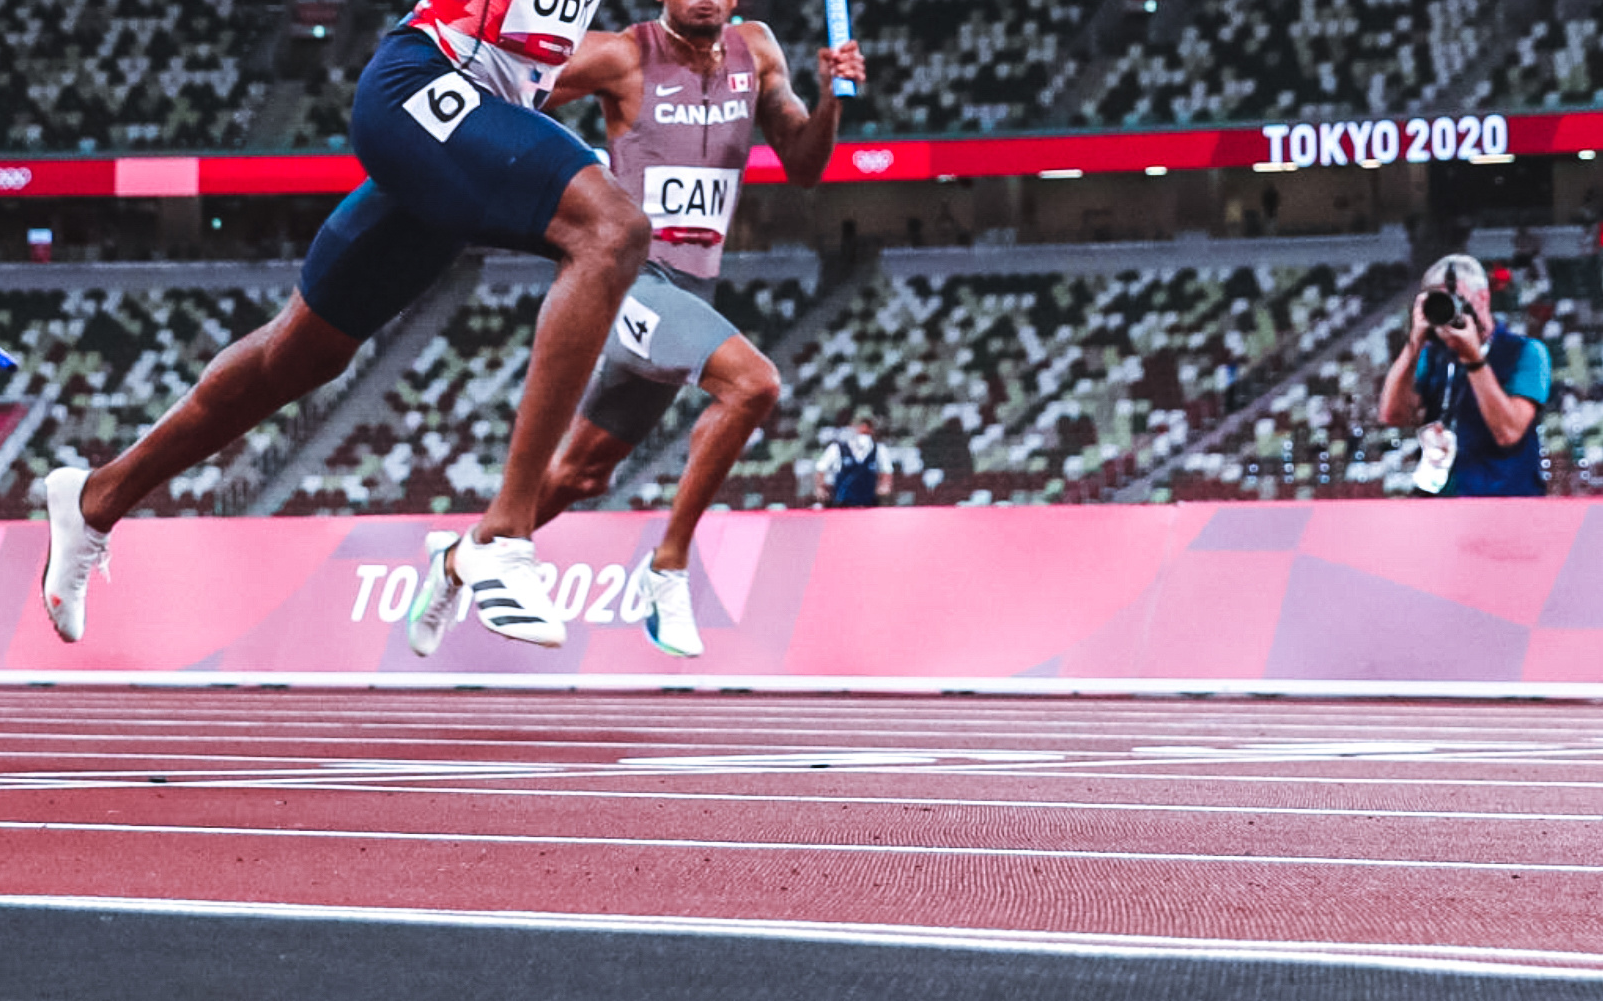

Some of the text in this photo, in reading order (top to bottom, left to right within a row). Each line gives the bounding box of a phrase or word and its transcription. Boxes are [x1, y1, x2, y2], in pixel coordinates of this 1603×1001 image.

[427, 88, 465, 123] 6
[654, 100, 748, 125] CANADA
[1262, 114, 1508, 167] TOKYO 2020
[662, 178, 728, 216] CAN
[623, 314, 648, 343] 4
